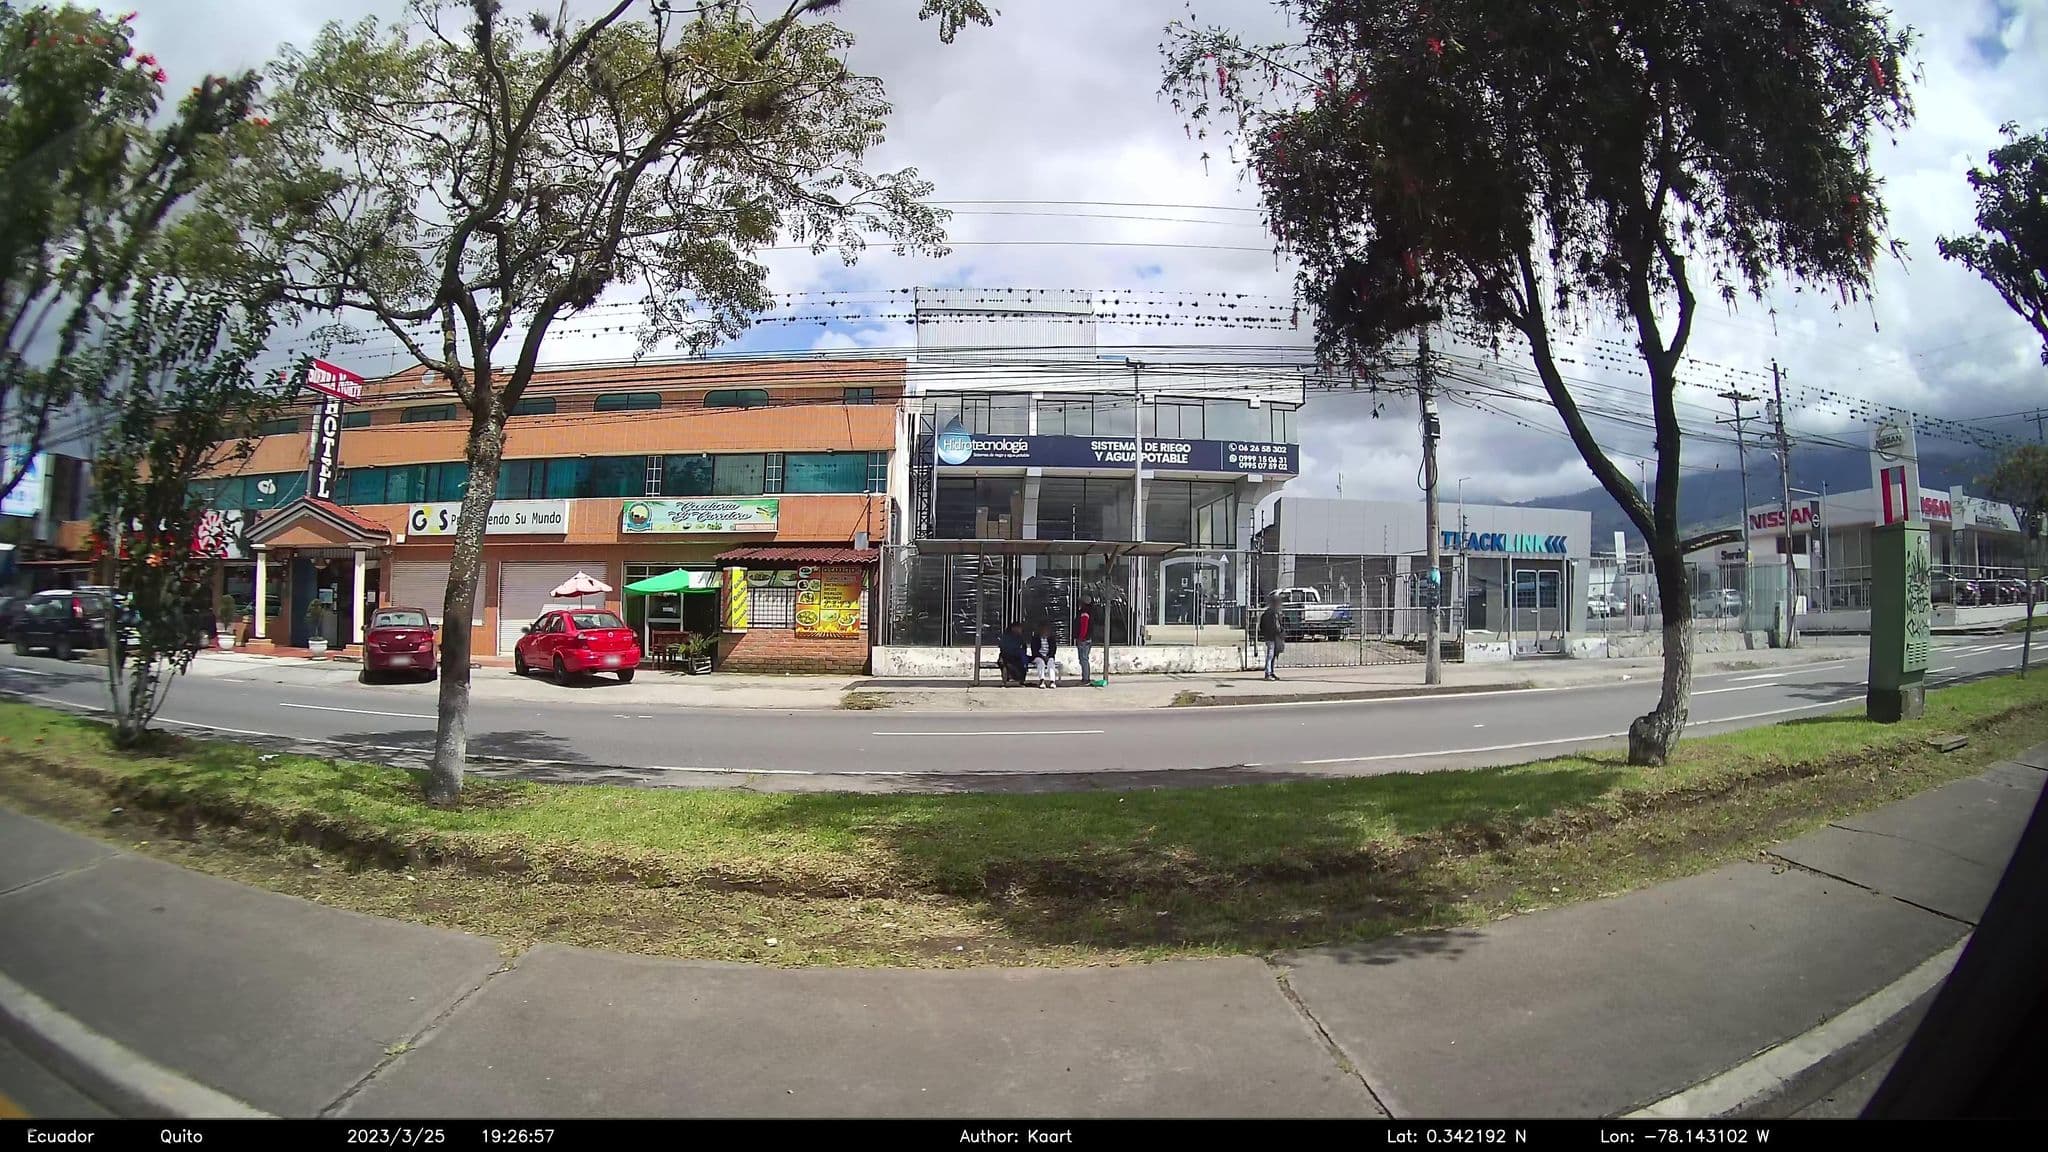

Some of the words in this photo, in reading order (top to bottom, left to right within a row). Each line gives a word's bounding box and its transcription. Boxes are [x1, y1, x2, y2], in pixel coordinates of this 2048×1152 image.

[317, 395, 340, 499] HOTEL
[943, 438, 1028, 453] Hidrotecnología
[1091, 441, 1142, 451] SISTEMA
[1144, 442, 1158, 452] DE
[1160, 443, 1192, 453] RIEGO
[1095, 452, 1103, 461] Y
[1105, 452, 1137, 462] AGUA
[1140, 453, 1188, 464] POTABLE
[1749, 507, 1812, 530] NISSAN
[1920, 496, 1951, 519] ISSAN
[412, 509, 448, 531] GS
[515, 513, 526, 524] Su
[532, 512, 561, 524] Mundo
